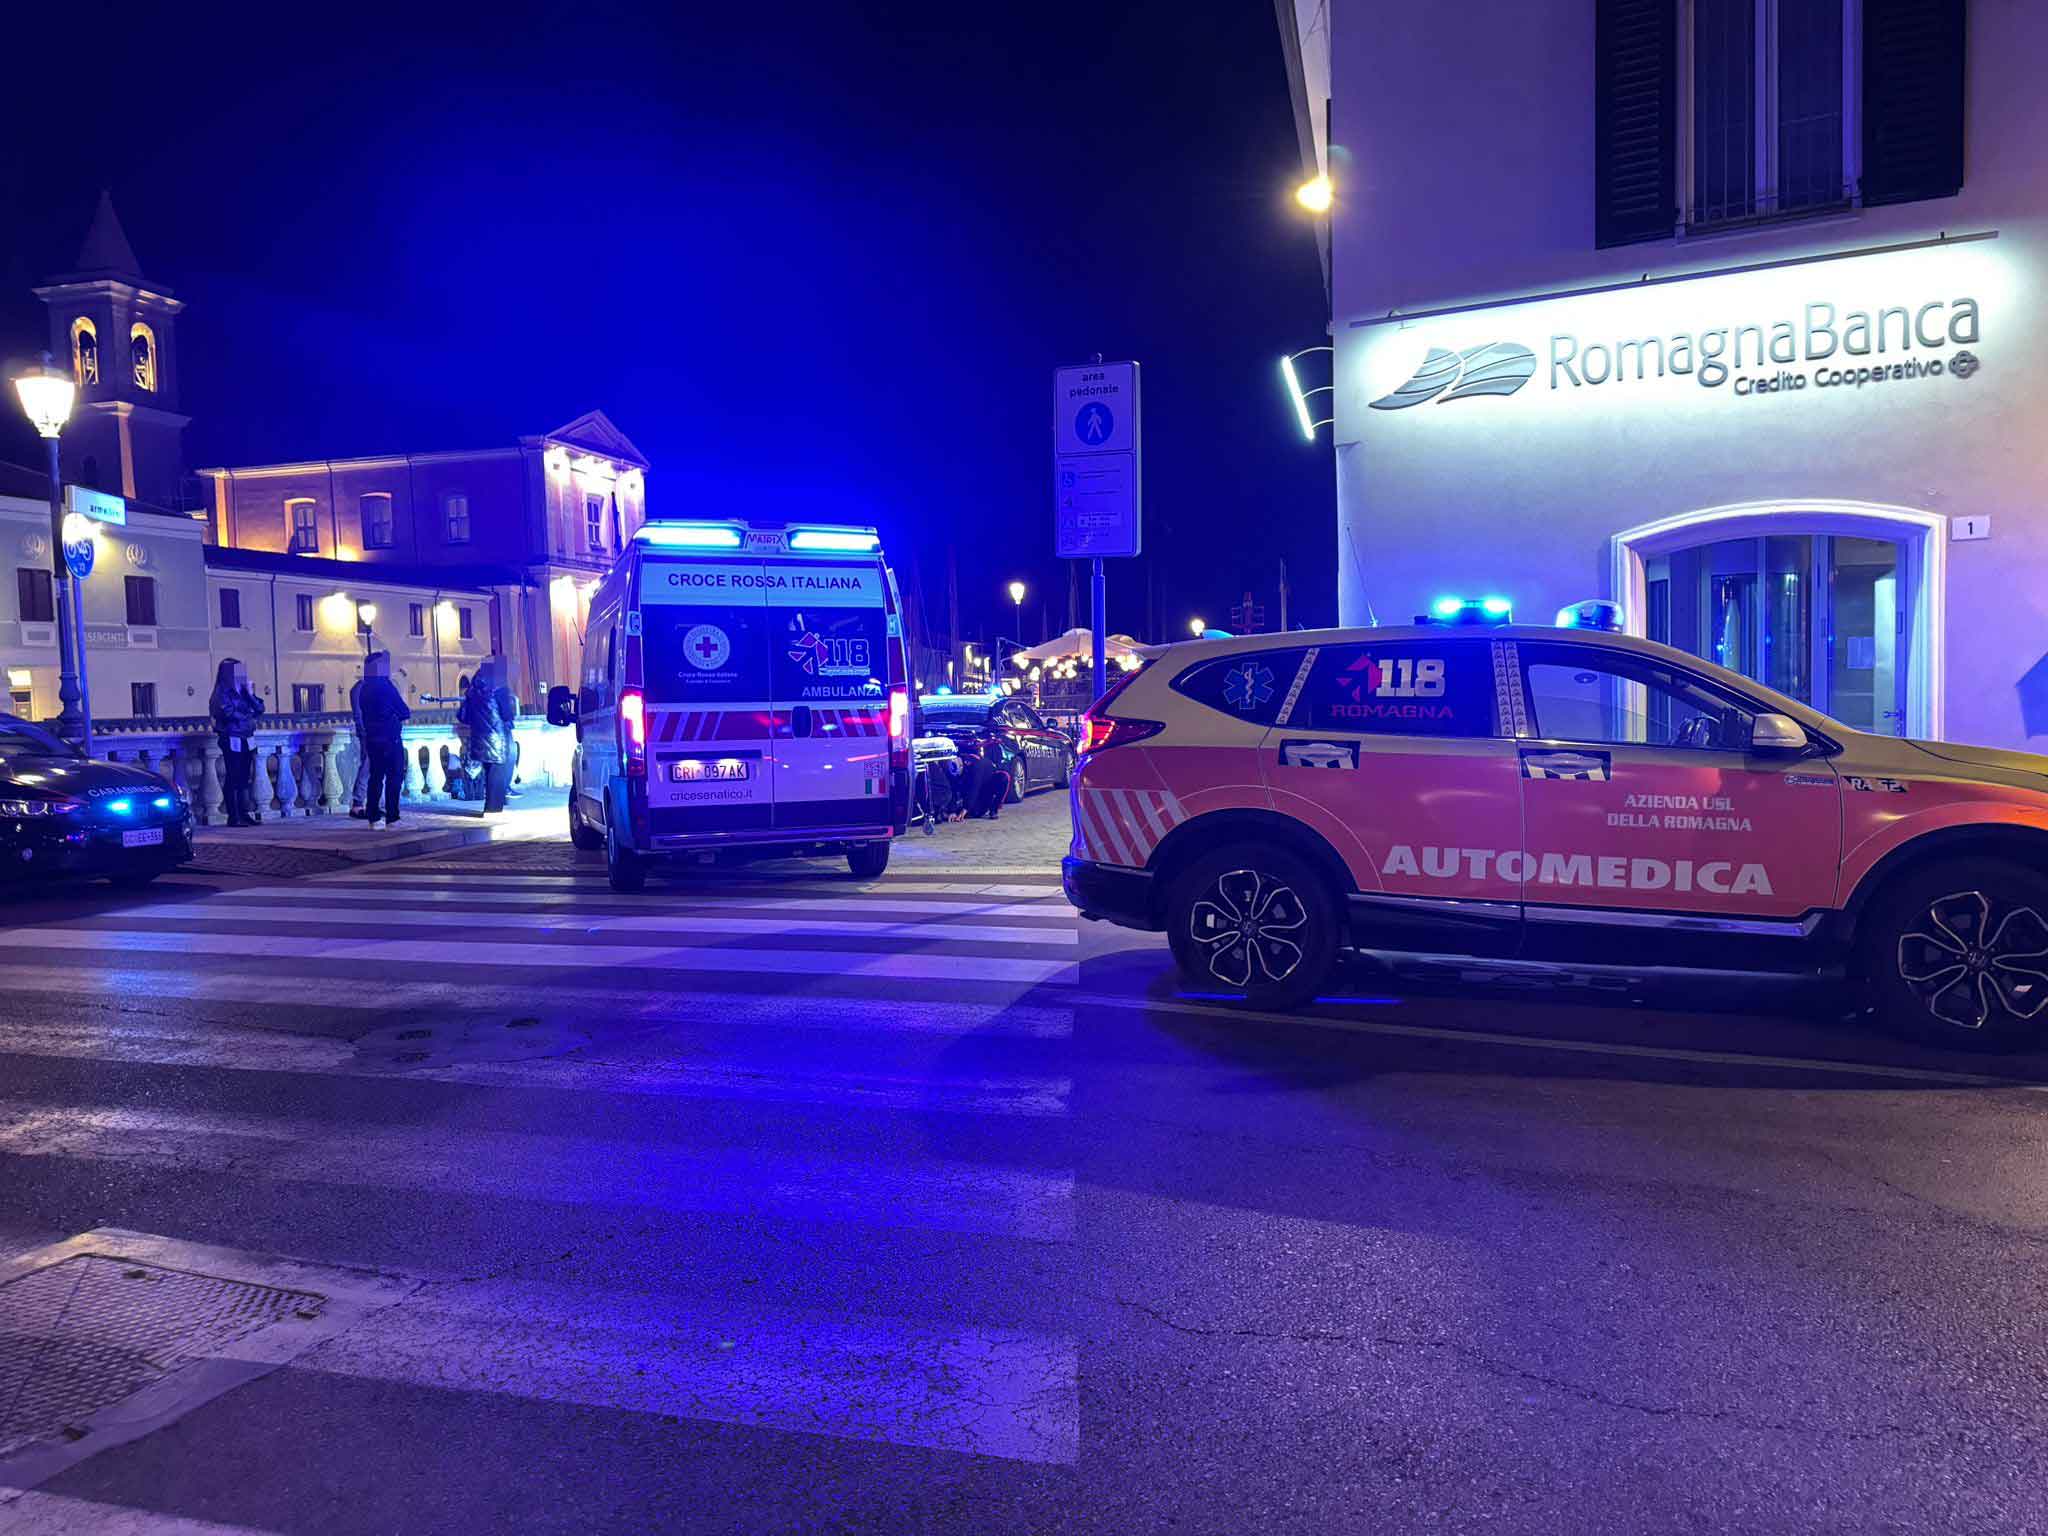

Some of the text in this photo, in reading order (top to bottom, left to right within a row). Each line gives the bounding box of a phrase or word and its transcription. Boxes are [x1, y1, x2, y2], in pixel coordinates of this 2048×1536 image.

[1549, 297, 1980, 389] RomagnaBanca
[1081, 372, 1105, 382] area
[1733, 357, 1943, 396] Credito Cooperativo
[1069, 384, 1120, 399] pedonale
[1967, 521, 1975, 535] 1
[744, 533, 786, 549] MATRIX
[668, 573, 862, 590] CROCE ROSSA ITALIANA
[821, 638, 870, 667] 118
[1376, 658, 1446, 697] 118
[802, 685, 883, 697] AMBULANZA
[1331, 704, 1454, 719] ROMAGNA
[675, 766, 695, 779] CRI
[1624, 794, 1735, 811] AZIENDA USL
[1607, 812, 1753, 832] DELLA ROMAGNA
[1382, 845, 1774, 895] AUTOMEDICA
